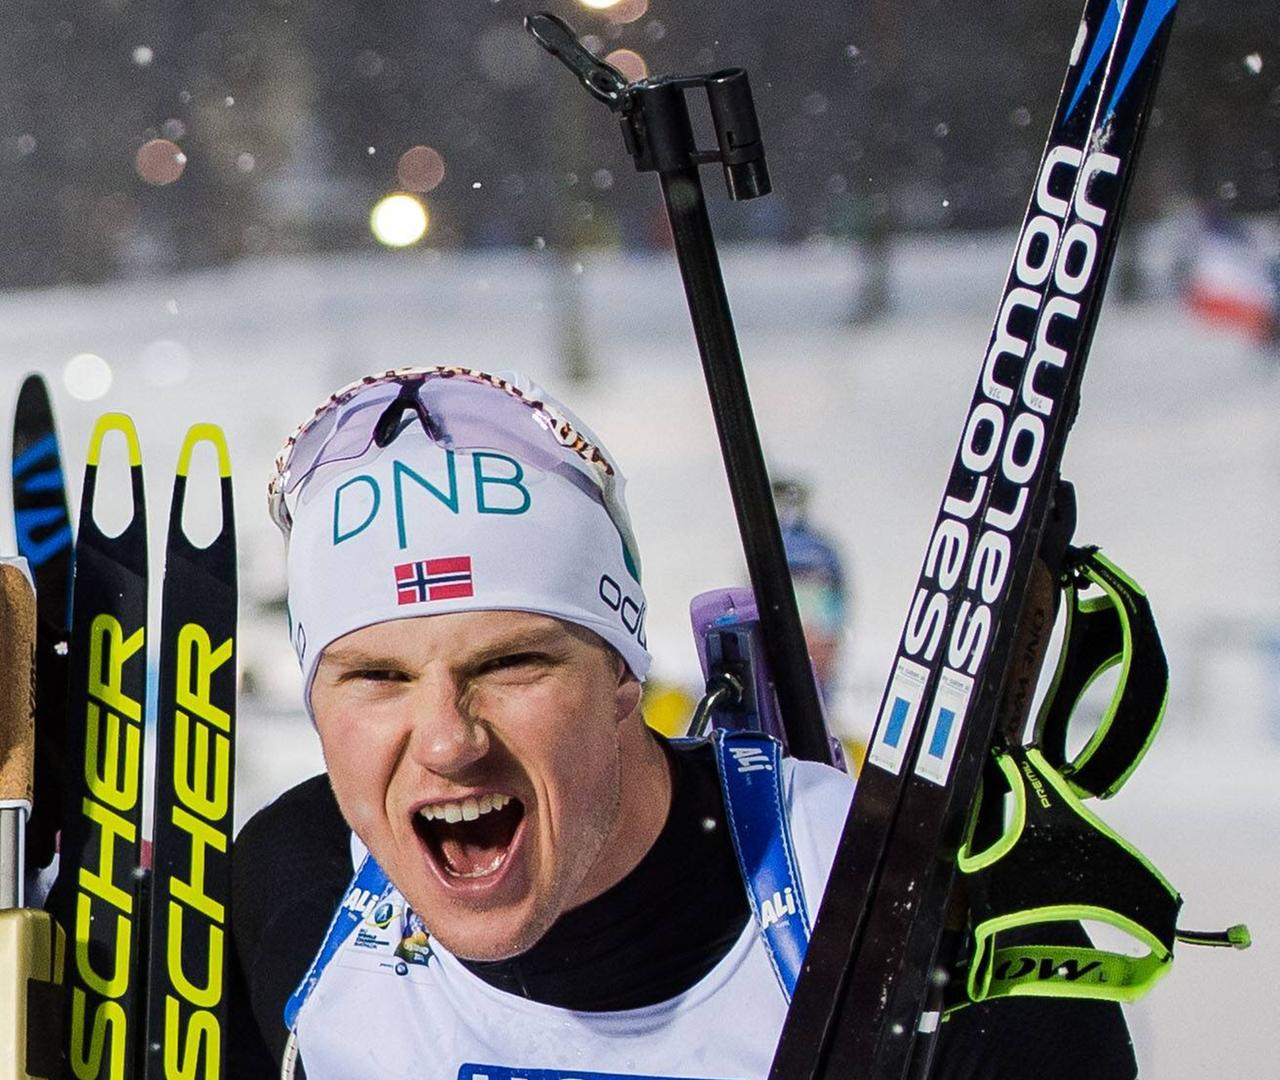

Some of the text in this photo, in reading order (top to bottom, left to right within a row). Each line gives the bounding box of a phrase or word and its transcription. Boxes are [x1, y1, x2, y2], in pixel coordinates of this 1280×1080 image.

[332, 449, 533, 550] DNB
[905, 145, 1083, 661] salomon
[948, 152, 1121, 675] salomon
